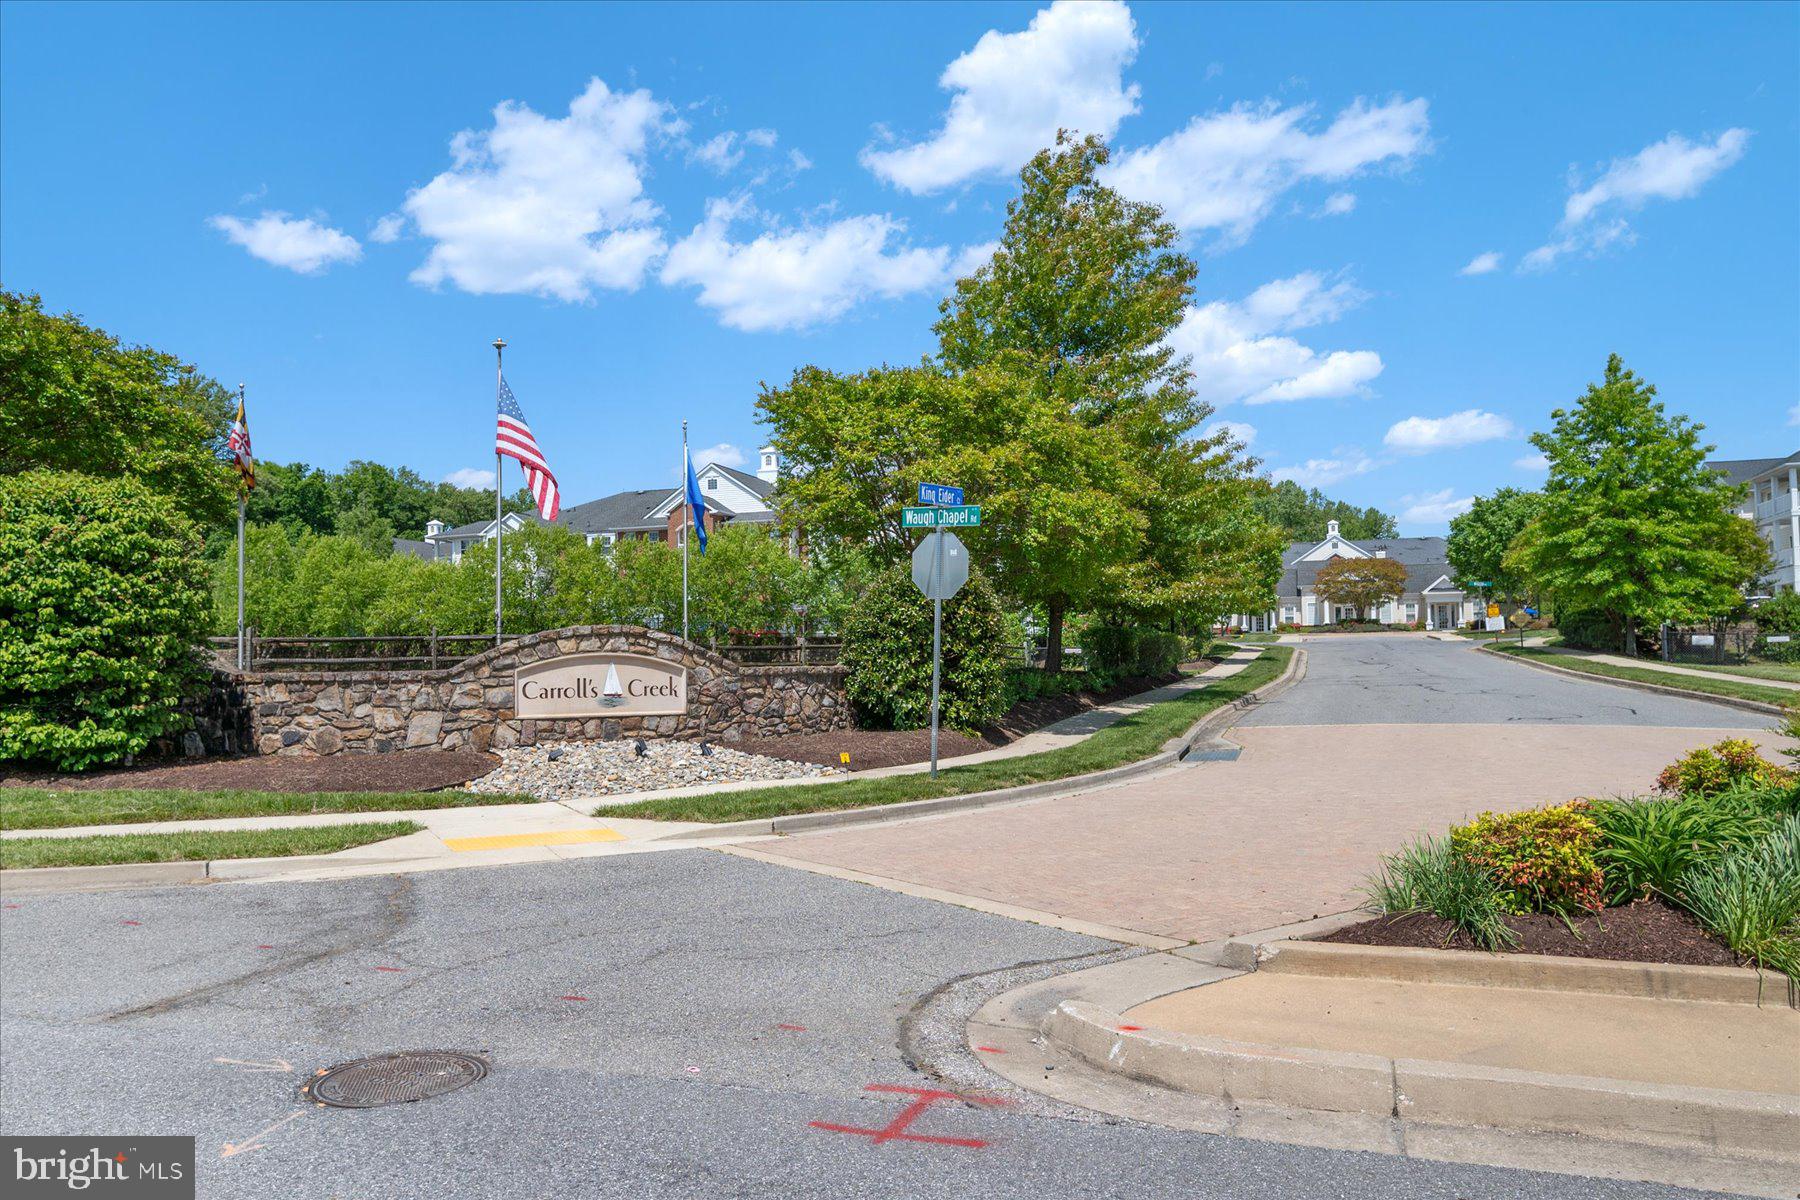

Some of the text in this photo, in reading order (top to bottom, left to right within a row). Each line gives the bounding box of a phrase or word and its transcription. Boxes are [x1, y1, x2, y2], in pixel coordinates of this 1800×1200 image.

[921, 485, 955, 504] King Eider
[905, 509, 935, 526] Waugh
[937, 508, 968, 526] Chapel
[522, 675, 679, 700] Carroll's Creek
